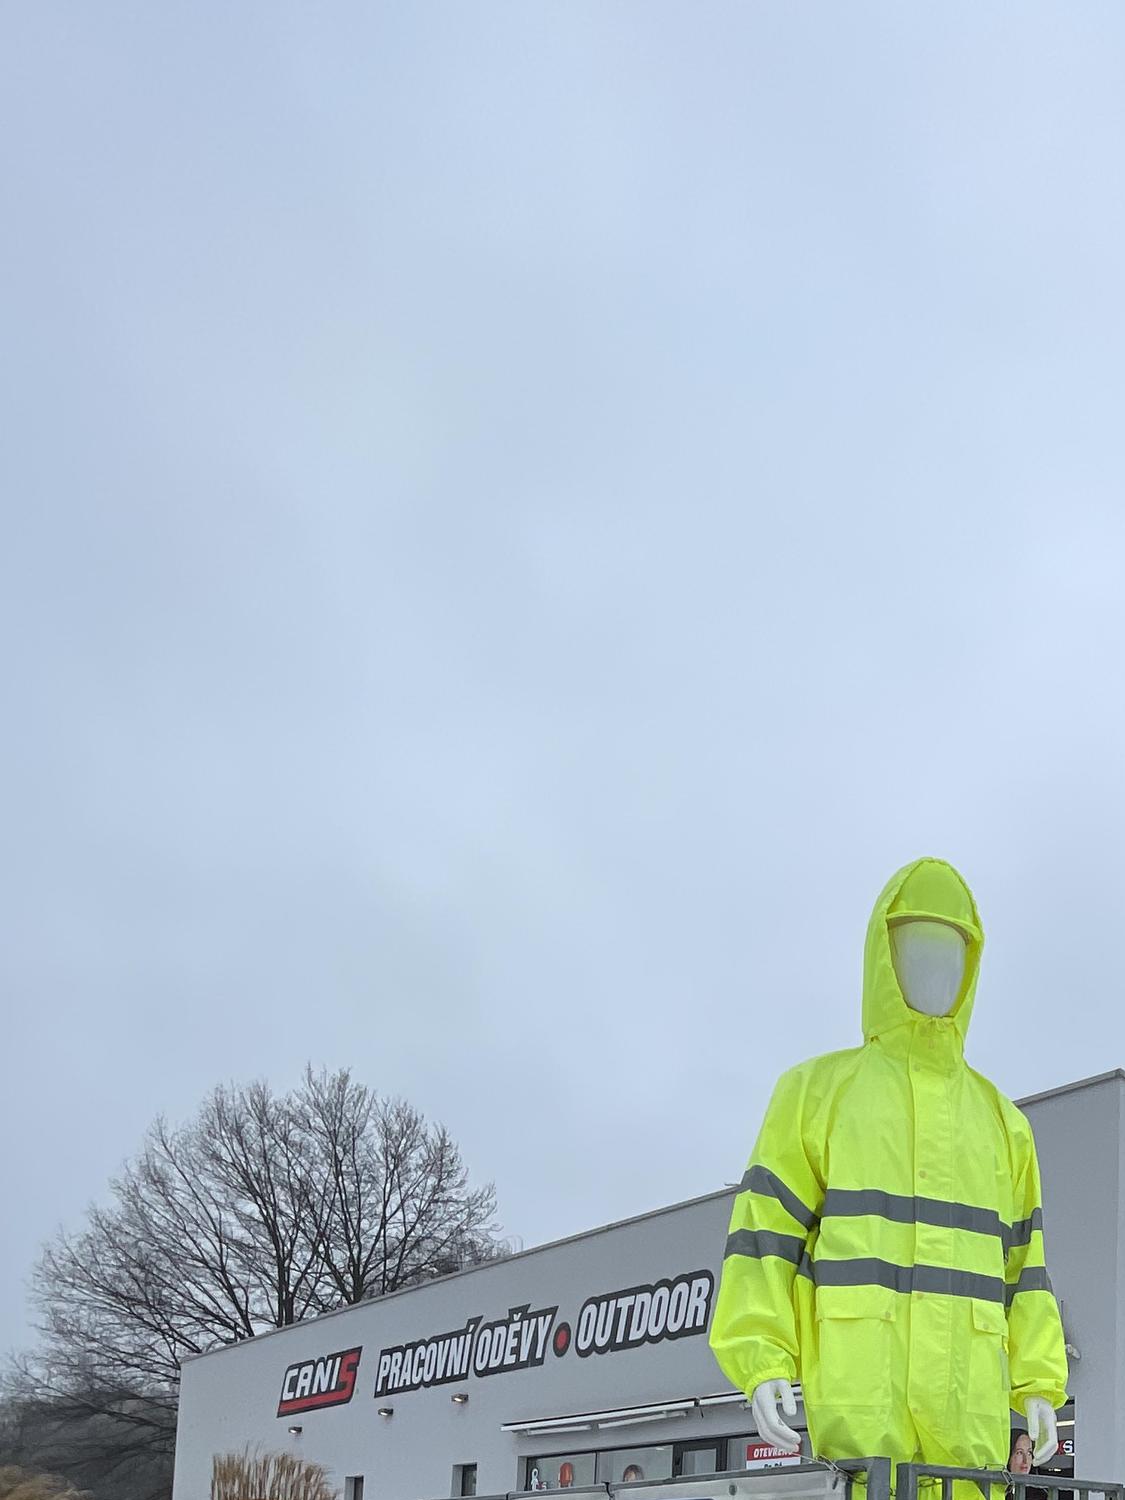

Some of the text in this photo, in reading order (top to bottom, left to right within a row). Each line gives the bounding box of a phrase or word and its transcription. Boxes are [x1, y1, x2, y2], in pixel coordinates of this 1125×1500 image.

[377, 1276, 712, 1392] PRACOVNÍ ODĚVY OUTDOOR
[280, 1351, 360, 1410] CANIS
